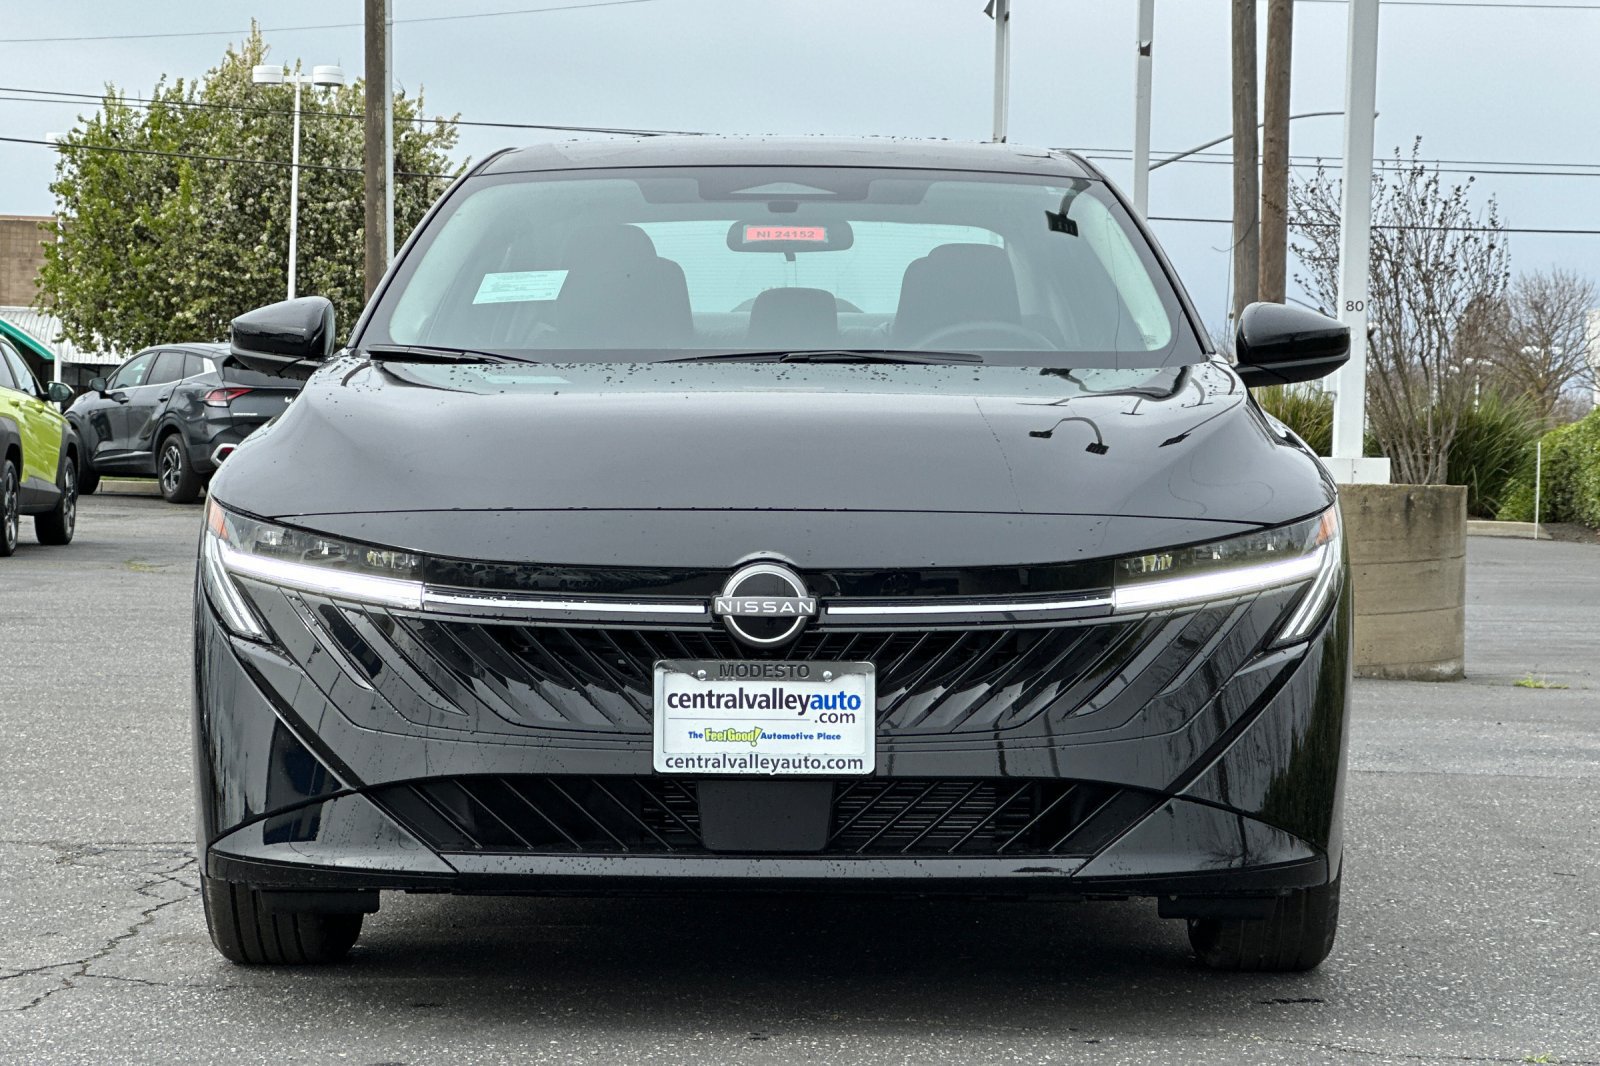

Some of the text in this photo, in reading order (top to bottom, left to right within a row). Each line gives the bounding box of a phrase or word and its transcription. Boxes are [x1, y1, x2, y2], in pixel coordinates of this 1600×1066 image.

[756, 230, 815, 239] NI 24152
[1345, 300, 1364, 312] 80
[717, 600, 814, 614] NISSAN
[719, 663, 810, 679] MODESTO
[667, 687, 861, 716] centralvalleyauto
[814, 712, 856, 724] .com
[688, 731, 704, 740] The
[760, 732, 815, 741] Automotive
[817, 732, 842, 741] Place
[665, 753, 864, 773] centralvalleyauto.com
